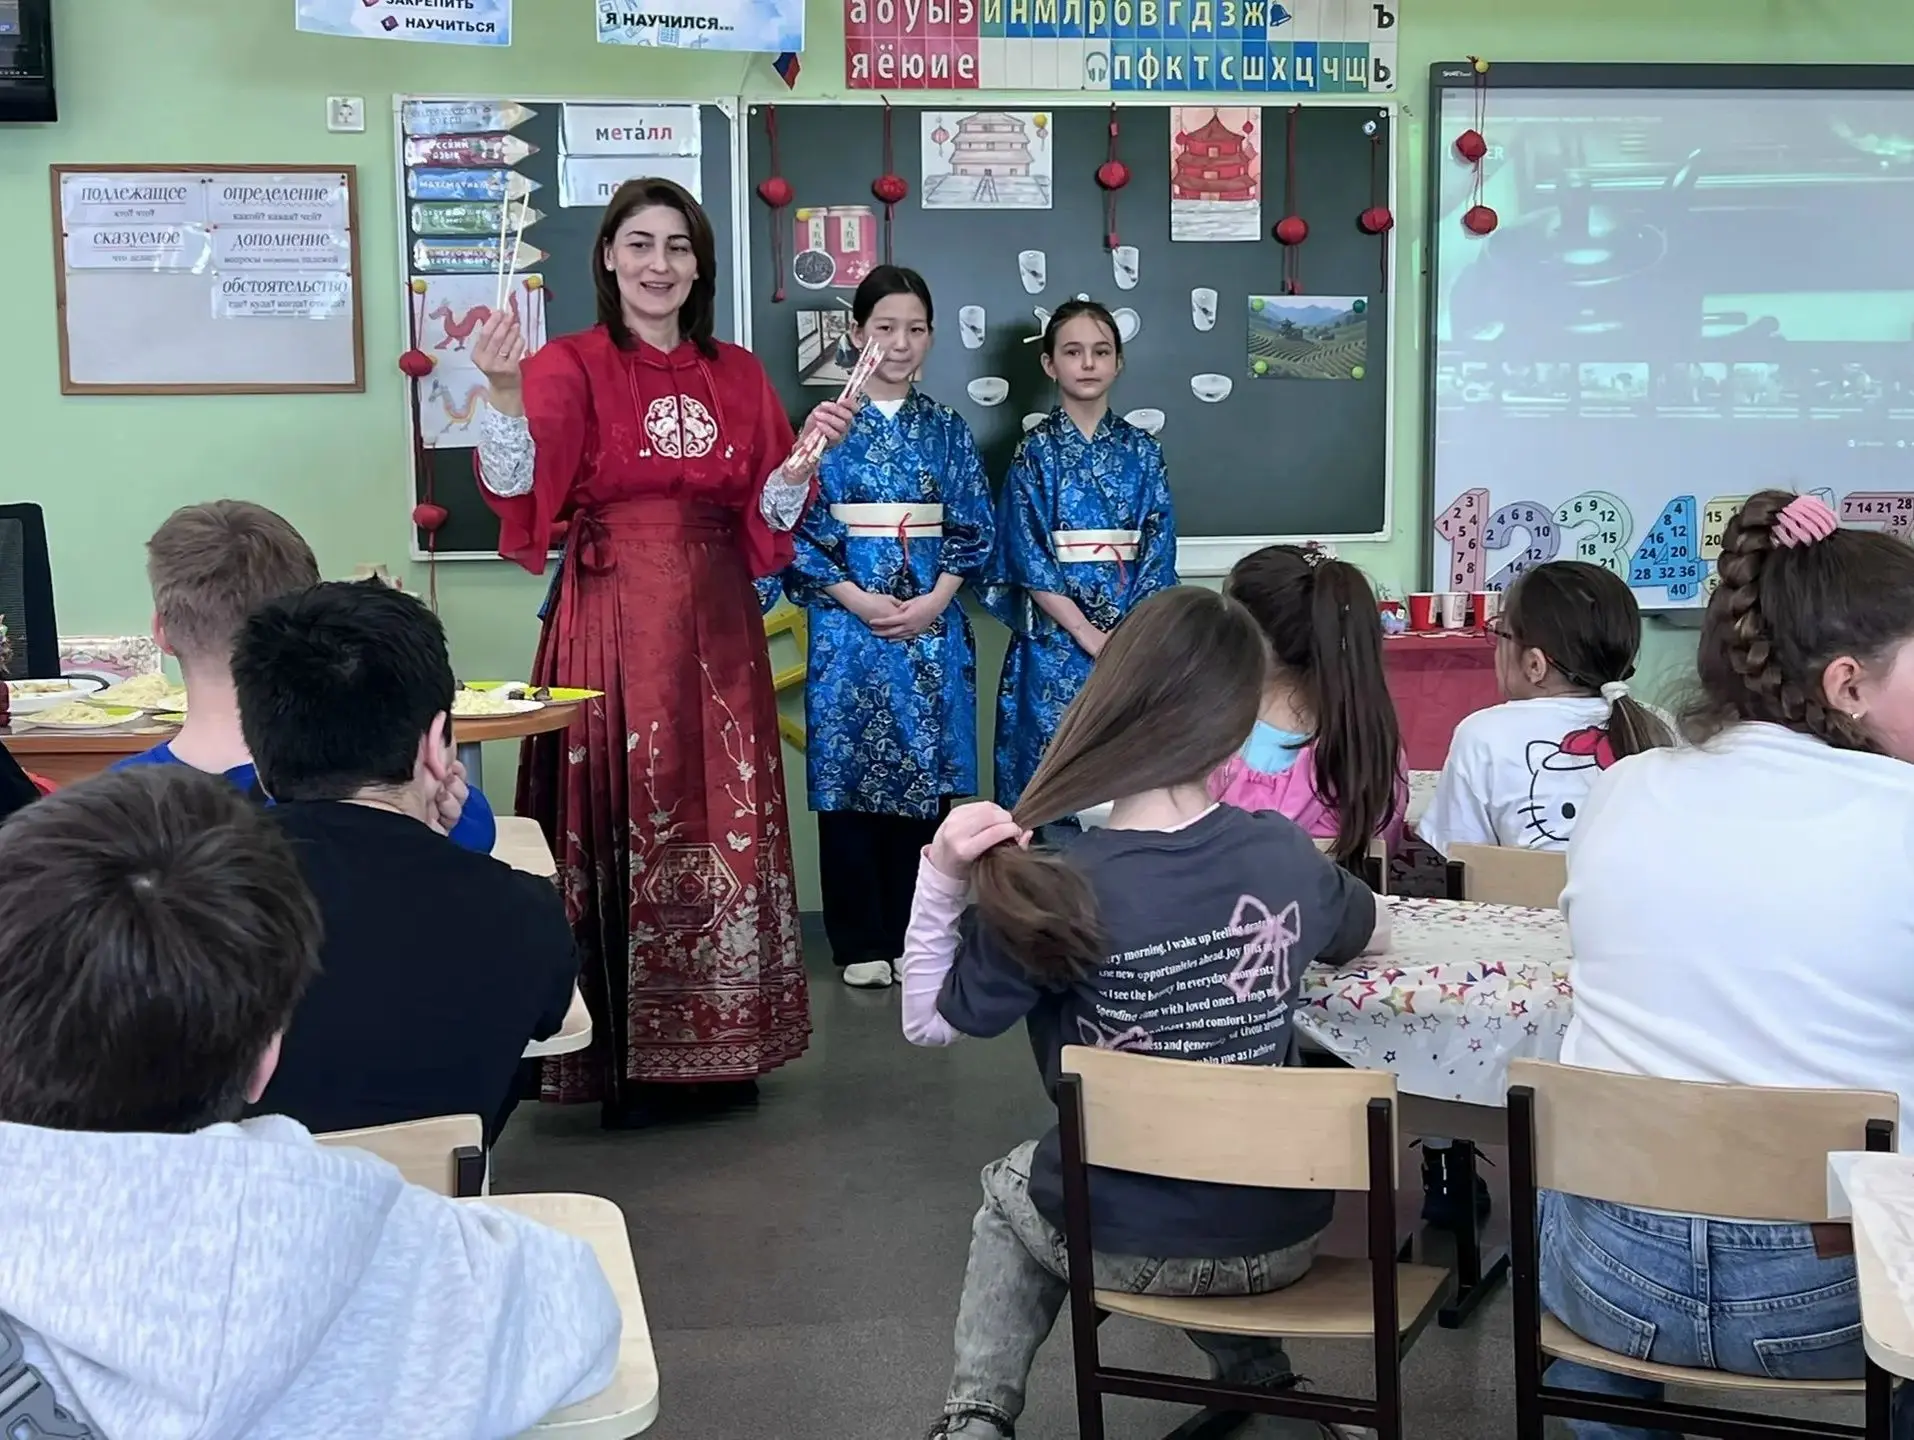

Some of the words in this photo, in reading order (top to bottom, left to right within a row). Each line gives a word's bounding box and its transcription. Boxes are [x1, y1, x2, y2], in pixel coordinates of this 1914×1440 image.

[405, 18, 495, 32] НАУЧИТЬСЯ
[606, 13, 617, 24] Я
[623, 13, 734, 31] НАУЧИЛСЯ...
[82, 187, 187, 202] подлежащее
[223, 187, 328, 203] определение
[93, 231, 180, 248] сказуемое
[232, 233, 330, 249] дополнение
[222, 276, 348, 293] обстоятельство
[1466, 497, 1474, 508] 3
[1574, 501, 1582, 513] 6
[1589, 500, 1598, 511] 9
[1674, 503, 1682, 514] 4
[1844, 502, 1852, 513] 7
[1857, 502, 1872, 513] 14
[1877, 502, 1892, 513] 21
[1897, 498, 1912, 510] 28
[1453, 508, 1461, 519] 2
[1469, 514, 1477, 525] 4
[1511, 509, 1519, 520] 6
[1525, 510, 1534, 522] 8
[1560, 511, 1568, 522] 3
[1599, 511, 1615, 522] 12
[1706, 511, 1722, 523] 15
[1442, 520, 1449, 531] 1
[1664, 515, 1672, 526] 8
[1892, 515, 1907, 526] 35
[1458, 526, 1466, 537] 5
[1486, 530, 1494, 541] 2
[1534, 526, 1550, 537] 10
[1671, 526, 1687, 537] 12
[1468, 538, 1476, 550] 6
[1601, 532, 1617, 544] 15
[1648, 533, 1664, 544] 16
[1705, 534, 1721, 546] 20
[1526, 549, 1542, 560] 12
[1580, 544, 1596, 556] 18
[1640, 548, 1657, 560] 24
[1671, 546, 1687, 557] 20
[1457, 552, 1465, 563] 7
[1600, 558, 1615, 569] 21
[1467, 562, 1475, 574] 8
[1507, 562, 1523, 573] 14
[1634, 568, 1651, 580] 28
[1659, 567, 1676, 578] 32
[1679, 565, 1696, 577] 36
[1455, 573, 1463, 584] 9
[1486, 583, 1502, 592] 16
[1671, 584, 1687, 596] 40
[1124, 943, 1167, 961] morning,
[1166, 940, 1172, 951] I
[1172, 936, 1197, 949] wake
[1198, 933, 1211, 945] up
[1116, 970, 1135, 979] new
[1114, 991, 1129, 1000] see
[1130, 989, 1147, 1001] the
[1176, 980, 1186, 991] in
[1187, 972, 1229, 989] everyday
[1160, 1002, 1184, 1015] with
[1185, 998, 1211, 1012] loved
[1212, 996, 1235, 1007] ones
[1185, 1018, 1205, 1030] and
[1205, 1015, 1247, 1028] comfort.
[1164, 1039, 1182, 1051] and
[1220, 1053, 1236, 1065] me
[1237, 1050, 1248, 1061] as
